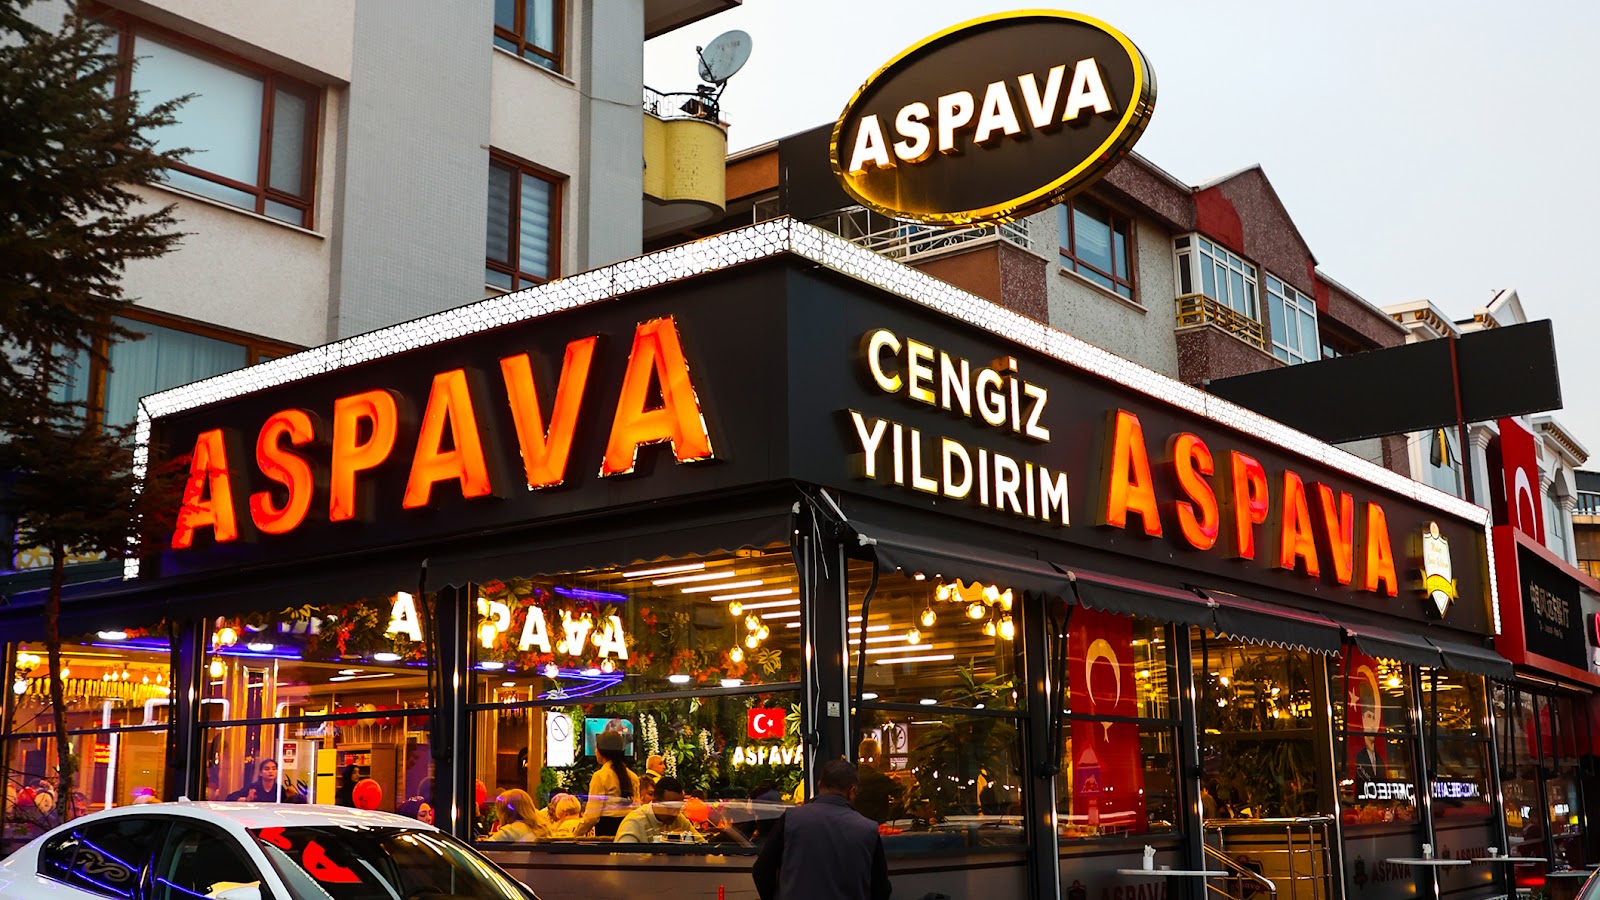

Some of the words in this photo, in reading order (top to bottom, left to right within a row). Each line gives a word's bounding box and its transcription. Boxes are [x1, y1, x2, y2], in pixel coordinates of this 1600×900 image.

[848, 57, 1113, 174] ASPAVA
[172, 316, 714, 548] ASPAVA
[867, 328, 1050, 442] CENGİZ
[849, 409, 1070, 527] YILDIRIM
[1106, 408, 1399, 597] ASPAVA
[1371, 860, 1412, 884] ASPAVA
